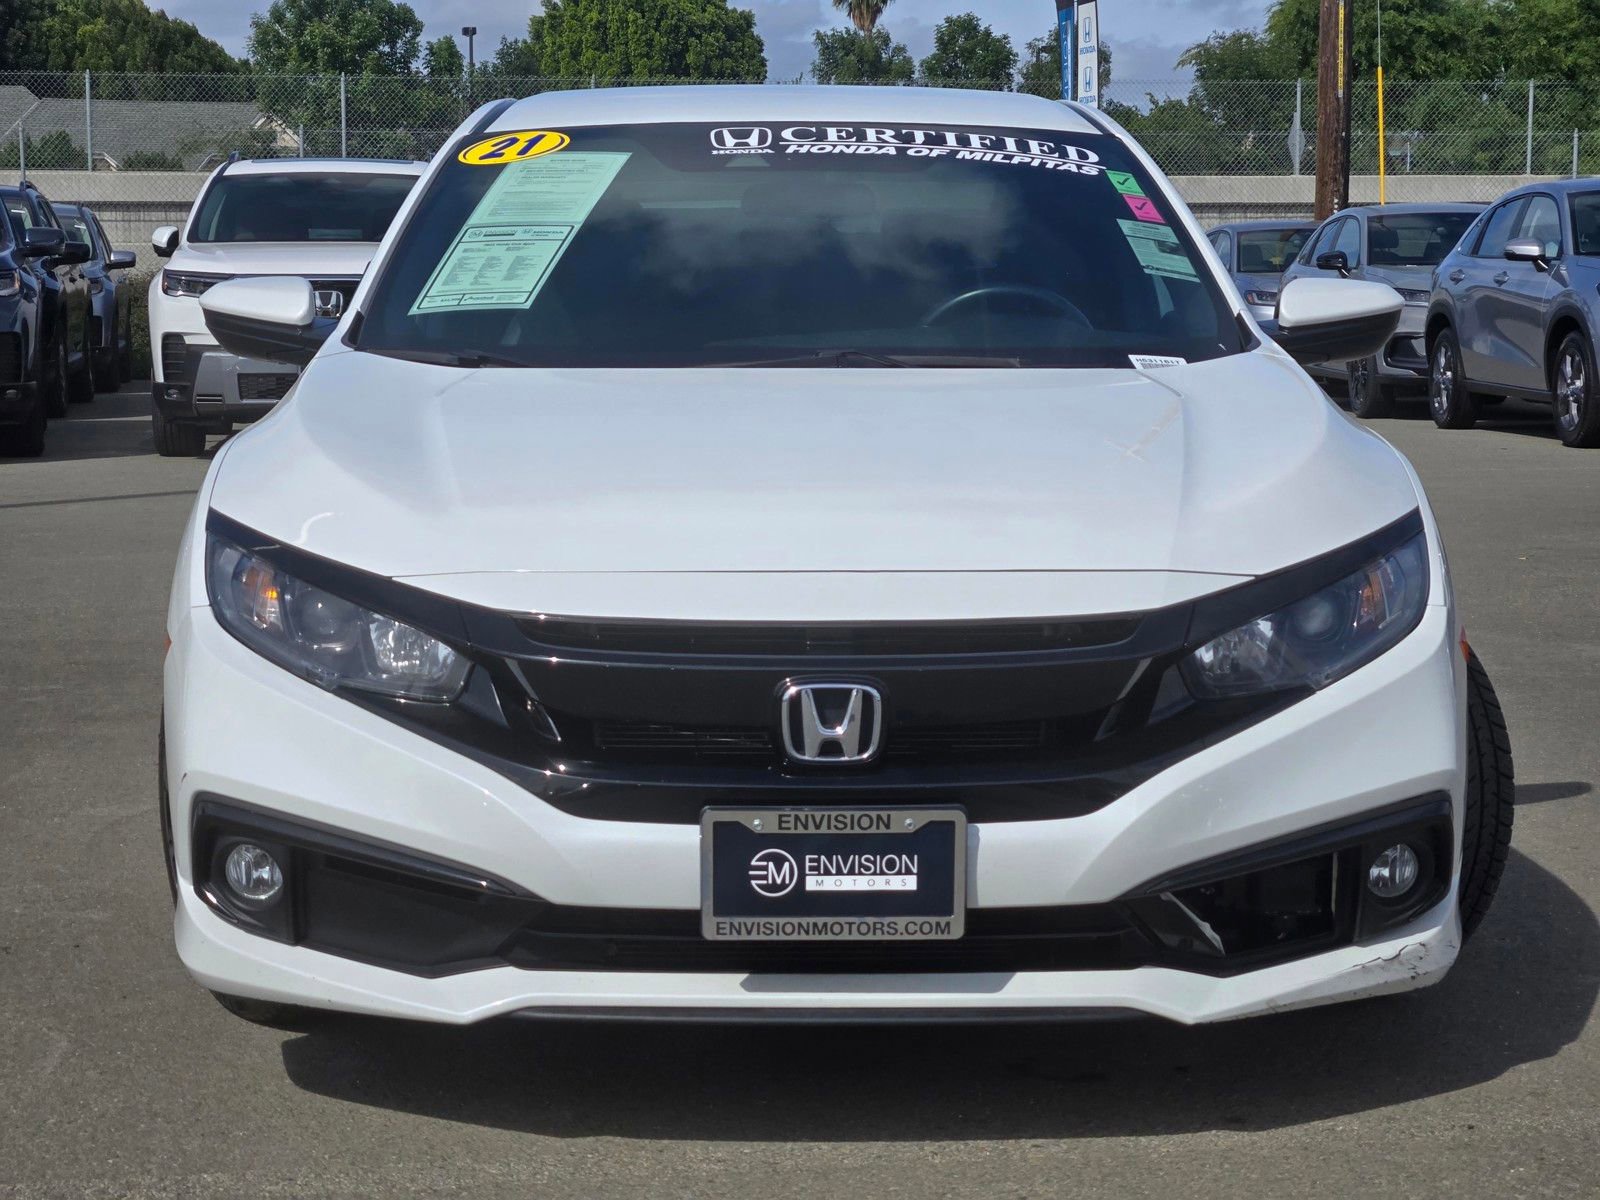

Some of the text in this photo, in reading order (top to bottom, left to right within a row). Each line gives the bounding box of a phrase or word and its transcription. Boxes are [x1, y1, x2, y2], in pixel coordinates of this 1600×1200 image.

[478, 133, 547, 160] 21
[780, 126, 1100, 163] CERTIFIED
[785, 144, 897, 155] HONDA
[906, 147, 951, 158] OF
[955, 150, 1100, 176] MILPITAS
[777, 813, 891, 832] ENVISION
[805, 854, 918, 875] ENVISION
[815, 878, 907, 887] MOTORS
[715, 920, 951, 937] ENVISIONMOTORS.COM
